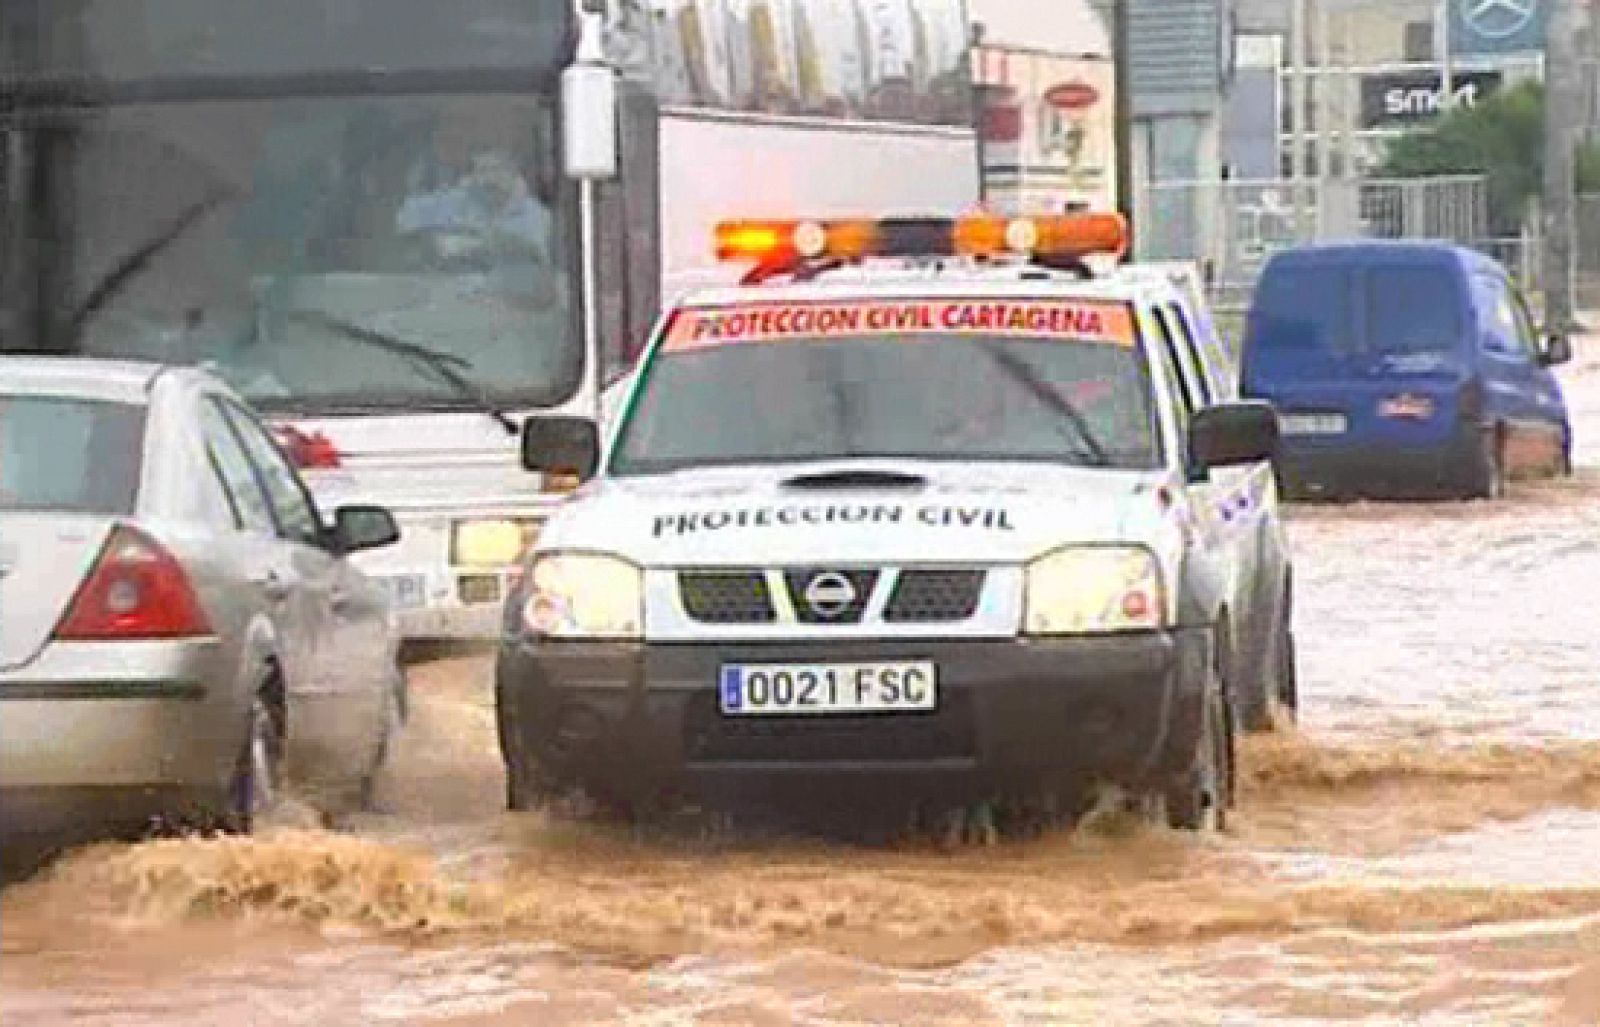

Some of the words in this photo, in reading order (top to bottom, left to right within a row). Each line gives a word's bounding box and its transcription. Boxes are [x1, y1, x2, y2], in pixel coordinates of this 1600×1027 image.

[692, 307, 860, 340] PROTECCION
[868, 305, 931, 329] CIVIL
[940, 305, 1103, 334] CARTAGENA
[652, 505, 901, 538] PROTECCION
[916, 506, 1015, 531] CIVIL
[748, 670, 836, 706] 0021
[854, 668, 926, 703] FSC
